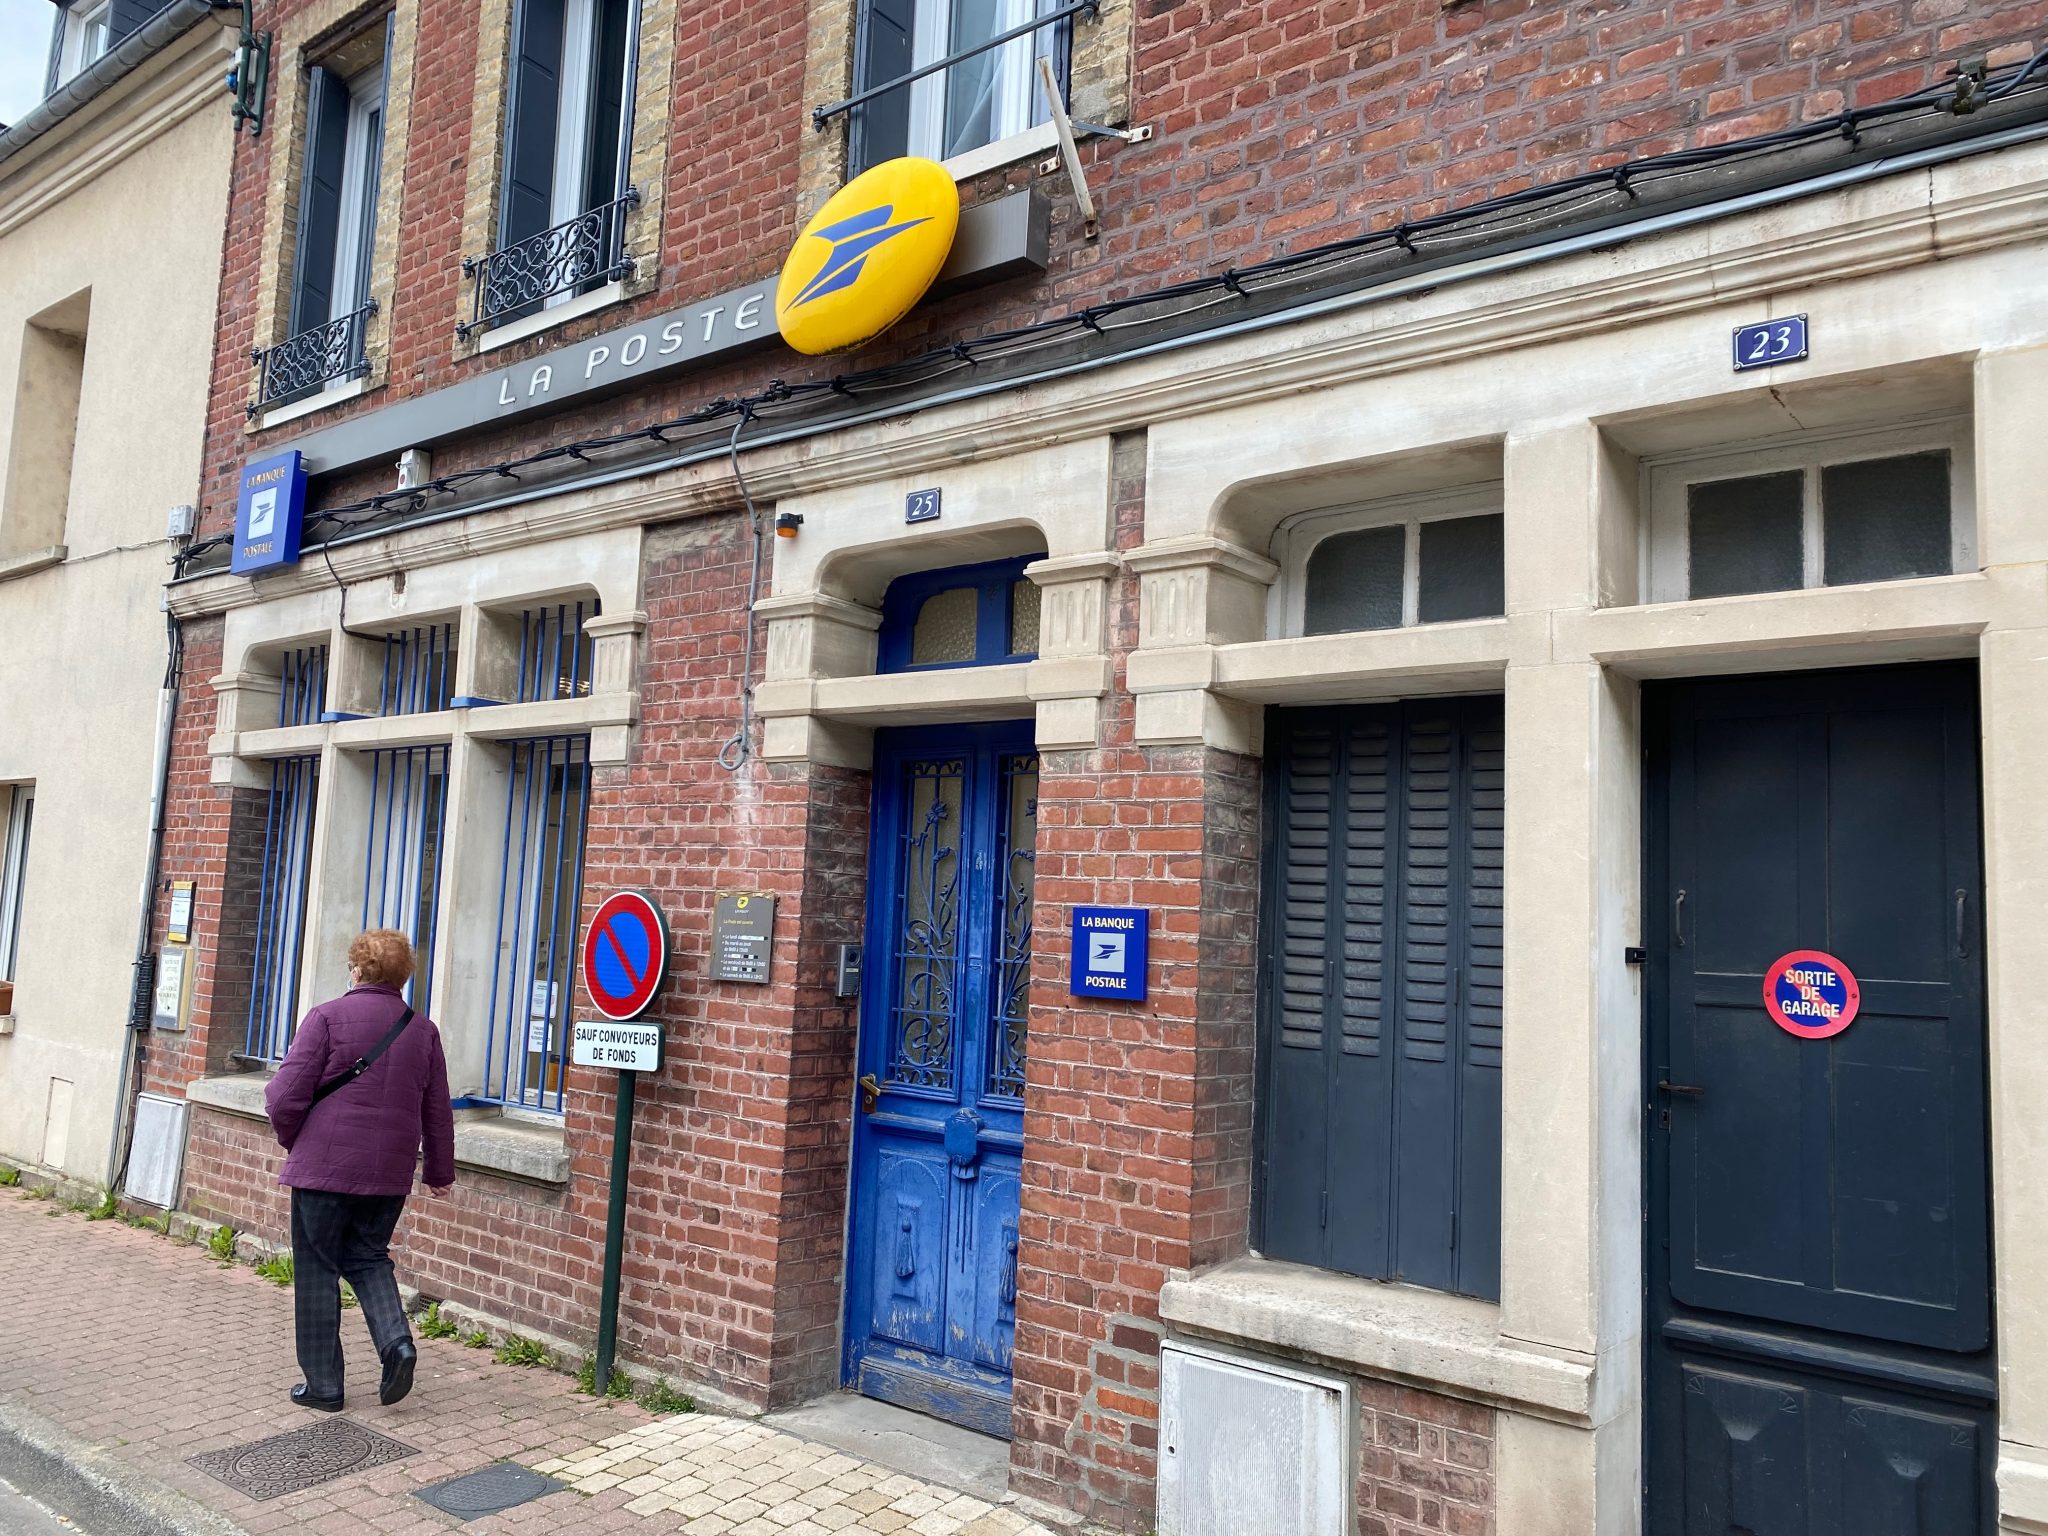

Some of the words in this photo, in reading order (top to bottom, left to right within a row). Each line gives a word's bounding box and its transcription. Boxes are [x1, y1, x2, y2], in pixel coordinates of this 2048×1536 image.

[499, 364, 553, 406] LA
[584, 292, 765, 379] POSTE
[1748, 326, 1791, 360] 23
[912, 494, 934, 516] 25
[243, 540, 273, 559] POSTALE
[1081, 916, 1093, 928] LA
[1094, 917, 1135, 930] BANQUE
[1085, 975, 1127, 989] POSTALE
[1785, 969, 1836, 987] SORTIE
[1801, 986, 1821, 1001] DE
[1781, 1000, 1840, 1018] GARAGE
[576, 1028, 598, 1042] SAUF
[598, 1029, 657, 1046] CONVOYEURS
[592, 1047, 604, 1060] DE
[607, 1048, 637, 1063] FONDS
